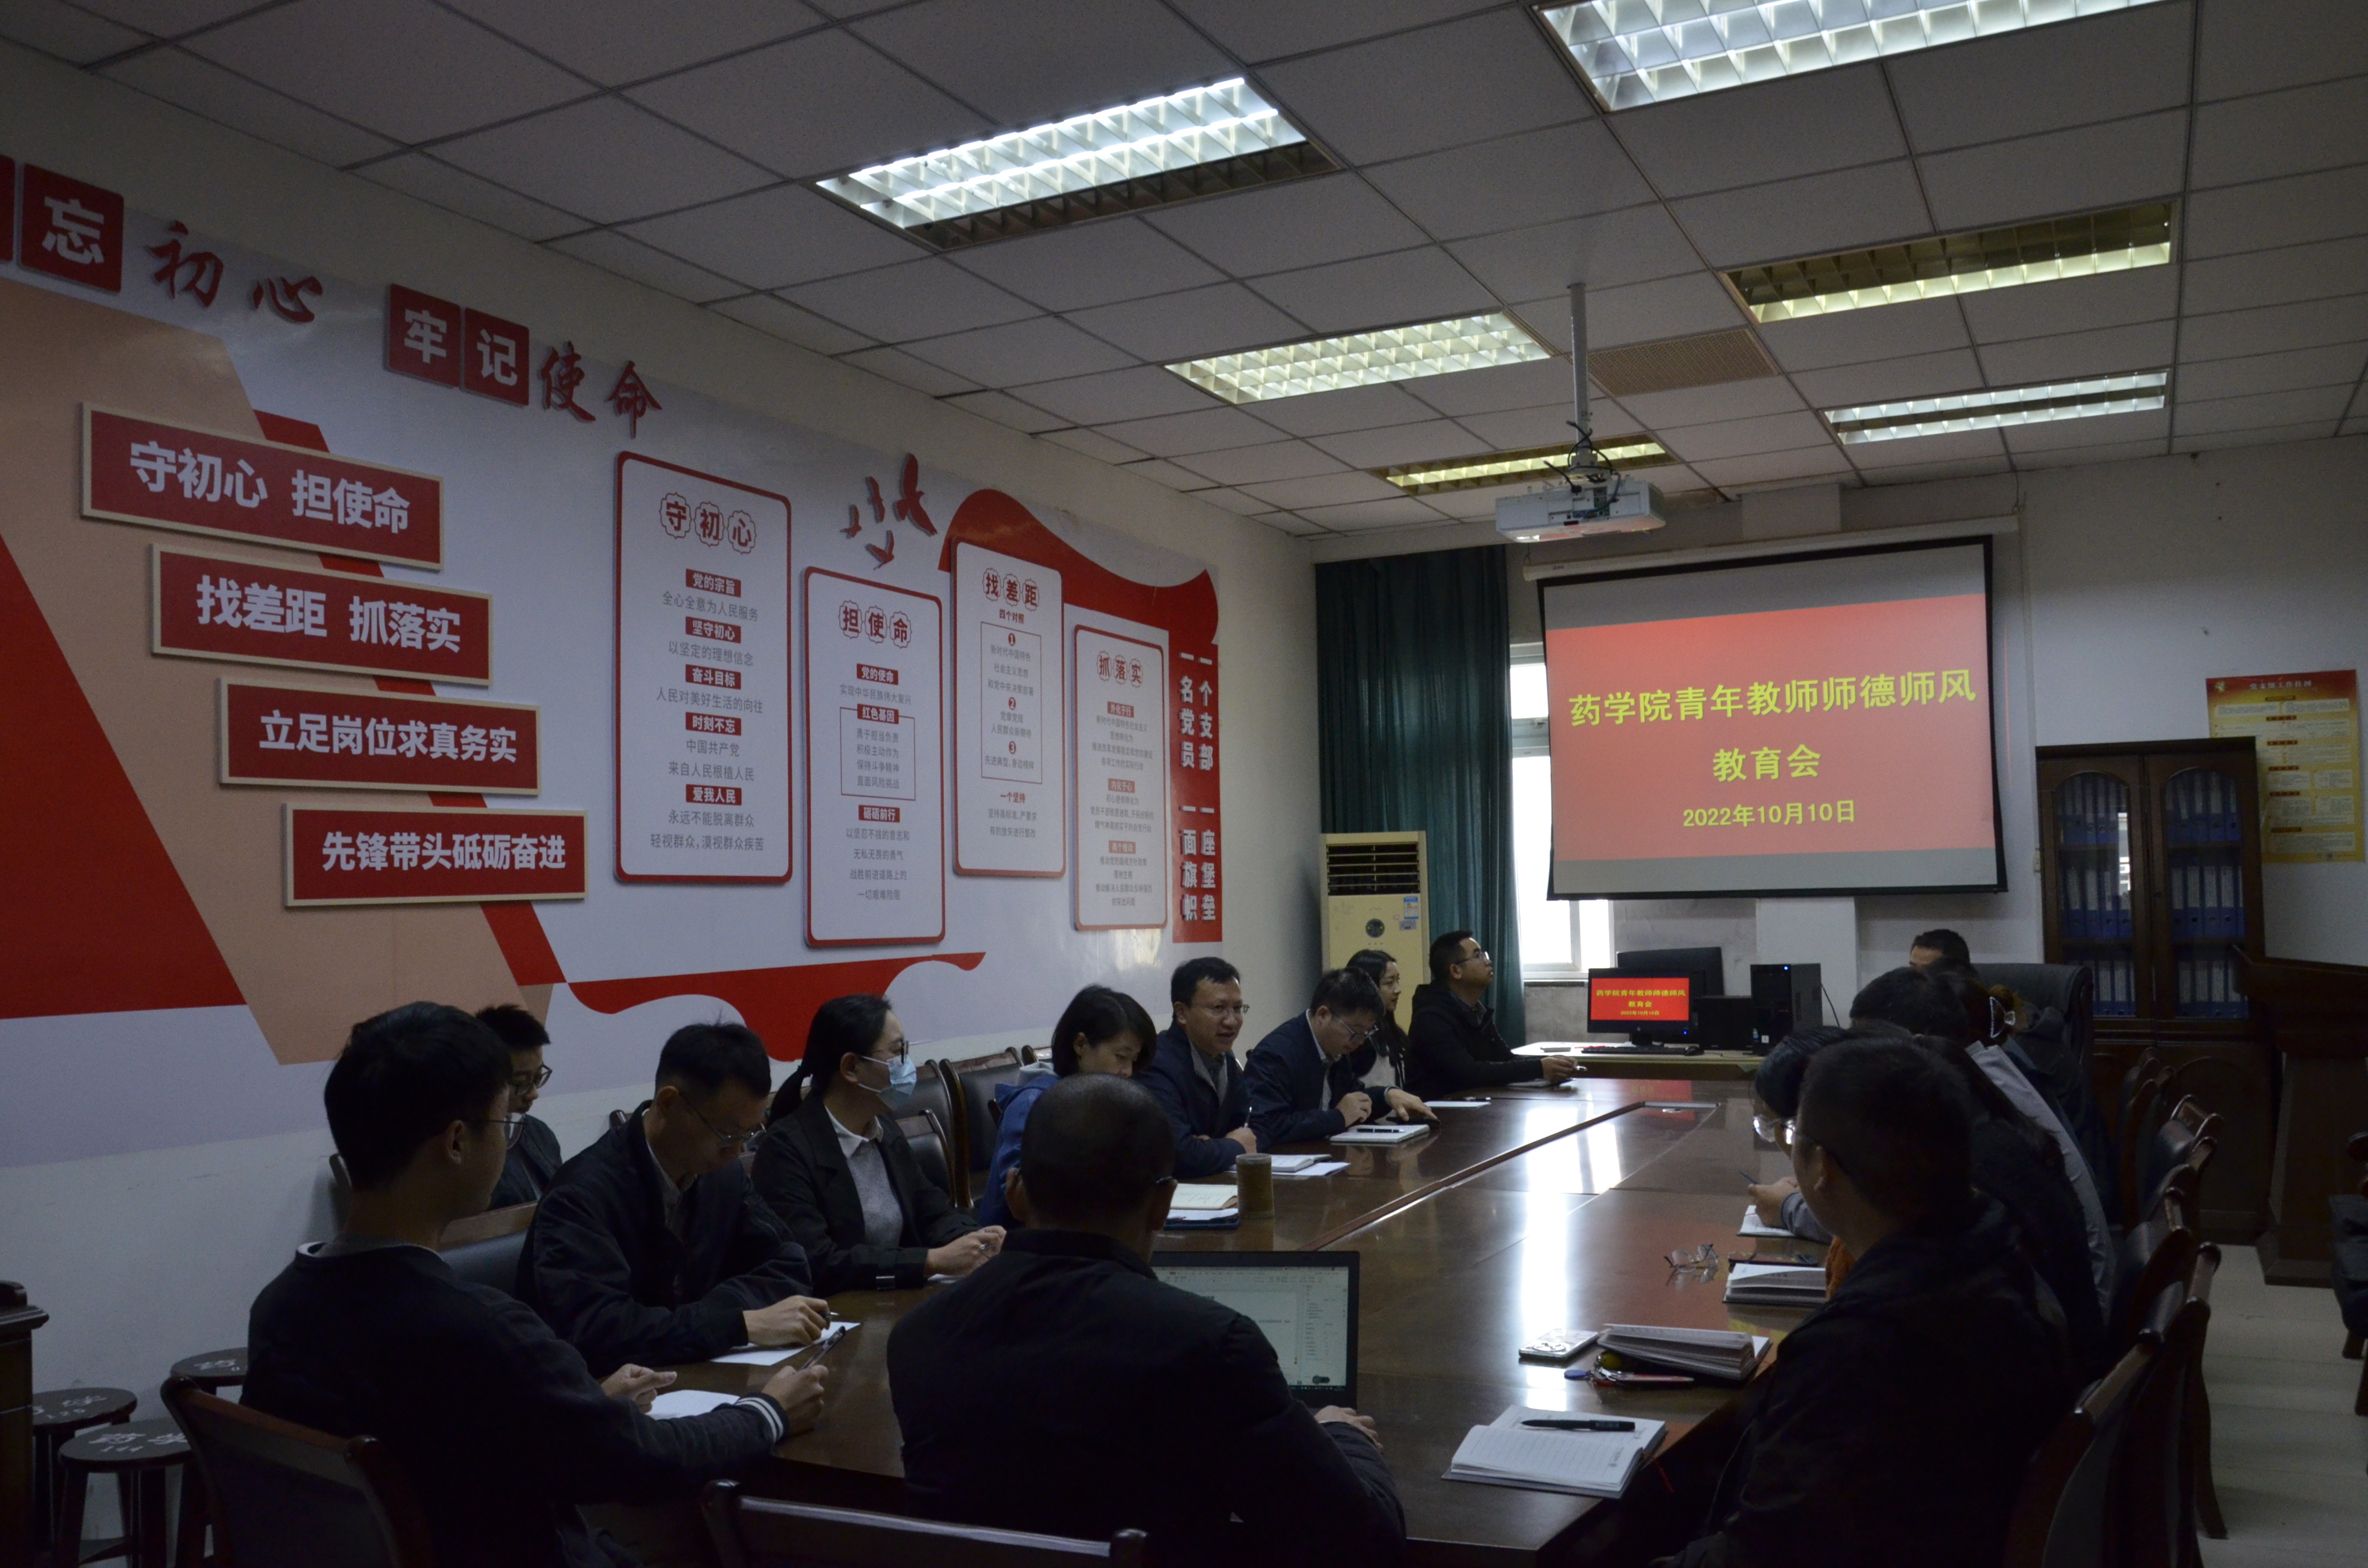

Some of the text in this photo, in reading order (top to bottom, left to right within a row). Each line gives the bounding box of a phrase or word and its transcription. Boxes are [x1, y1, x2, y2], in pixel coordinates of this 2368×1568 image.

[404, 309, 661, 439] 牢记使命
[130, 441, 409, 534] 守初心 担使命
[666, 501, 752, 548] 守初心
[693, 573, 735, 595] 党的宗旨
[986, 573, 1038, 607] 找差距
[196, 575, 461, 652] 找差距 抓落实
[663, 591, 758, 621] 全心全意为人民服务
[999, 609, 1025, 624] 四个对照
[693, 620, 735, 640] 坚守初心
[843, 607, 909, 644] 担使命
[668, 641, 753, 666] 以坚定的理想信念
[692, 667, 735, 687] 奋斗目标
[862, 666, 894, 683] 党的使命
[1098, 656, 1142, 683] 抓落实
[656, 686, 763, 714] 人民对美好生活的向往
[840, 685, 912, 705] 实现中华民族伟大复兴
[1569, 669, 1976, 727] 药学院青年教师师德师风
[692, 715, 735, 734] 时刻不忘
[862, 706, 895, 723] 红色基因
[259, 710, 517, 763] 立足岗位求真务实
[856, 728, 899, 744] 勇于担当负责
[686, 740, 740, 758] 中国共产党
[856, 744, 899, 759] 积极主动作为
[668, 762, 754, 782] 来自人民根植人民
[857, 760, 900, 773] 保持斗争精神
[1713, 744, 1821, 782] 教育会
[692, 786, 736, 804] 爱我人民
[1179, 652, 1197, 921] 一名党员 一面旗帜
[1198, 657, 1216, 921] 一个支部 一座堡垒
[999, 792, 1026, 804] 一个坚持
[668, 810, 754, 828] 永远不能脱离群众
[1683, 800, 1855, 828] 2022年10月10日
[322, 832, 566, 871] 先锋带头砥砺奋进
[853, 848, 903, 861] 无私无畏的勇气
[1628, 1000, 1653, 1008] 教育会
